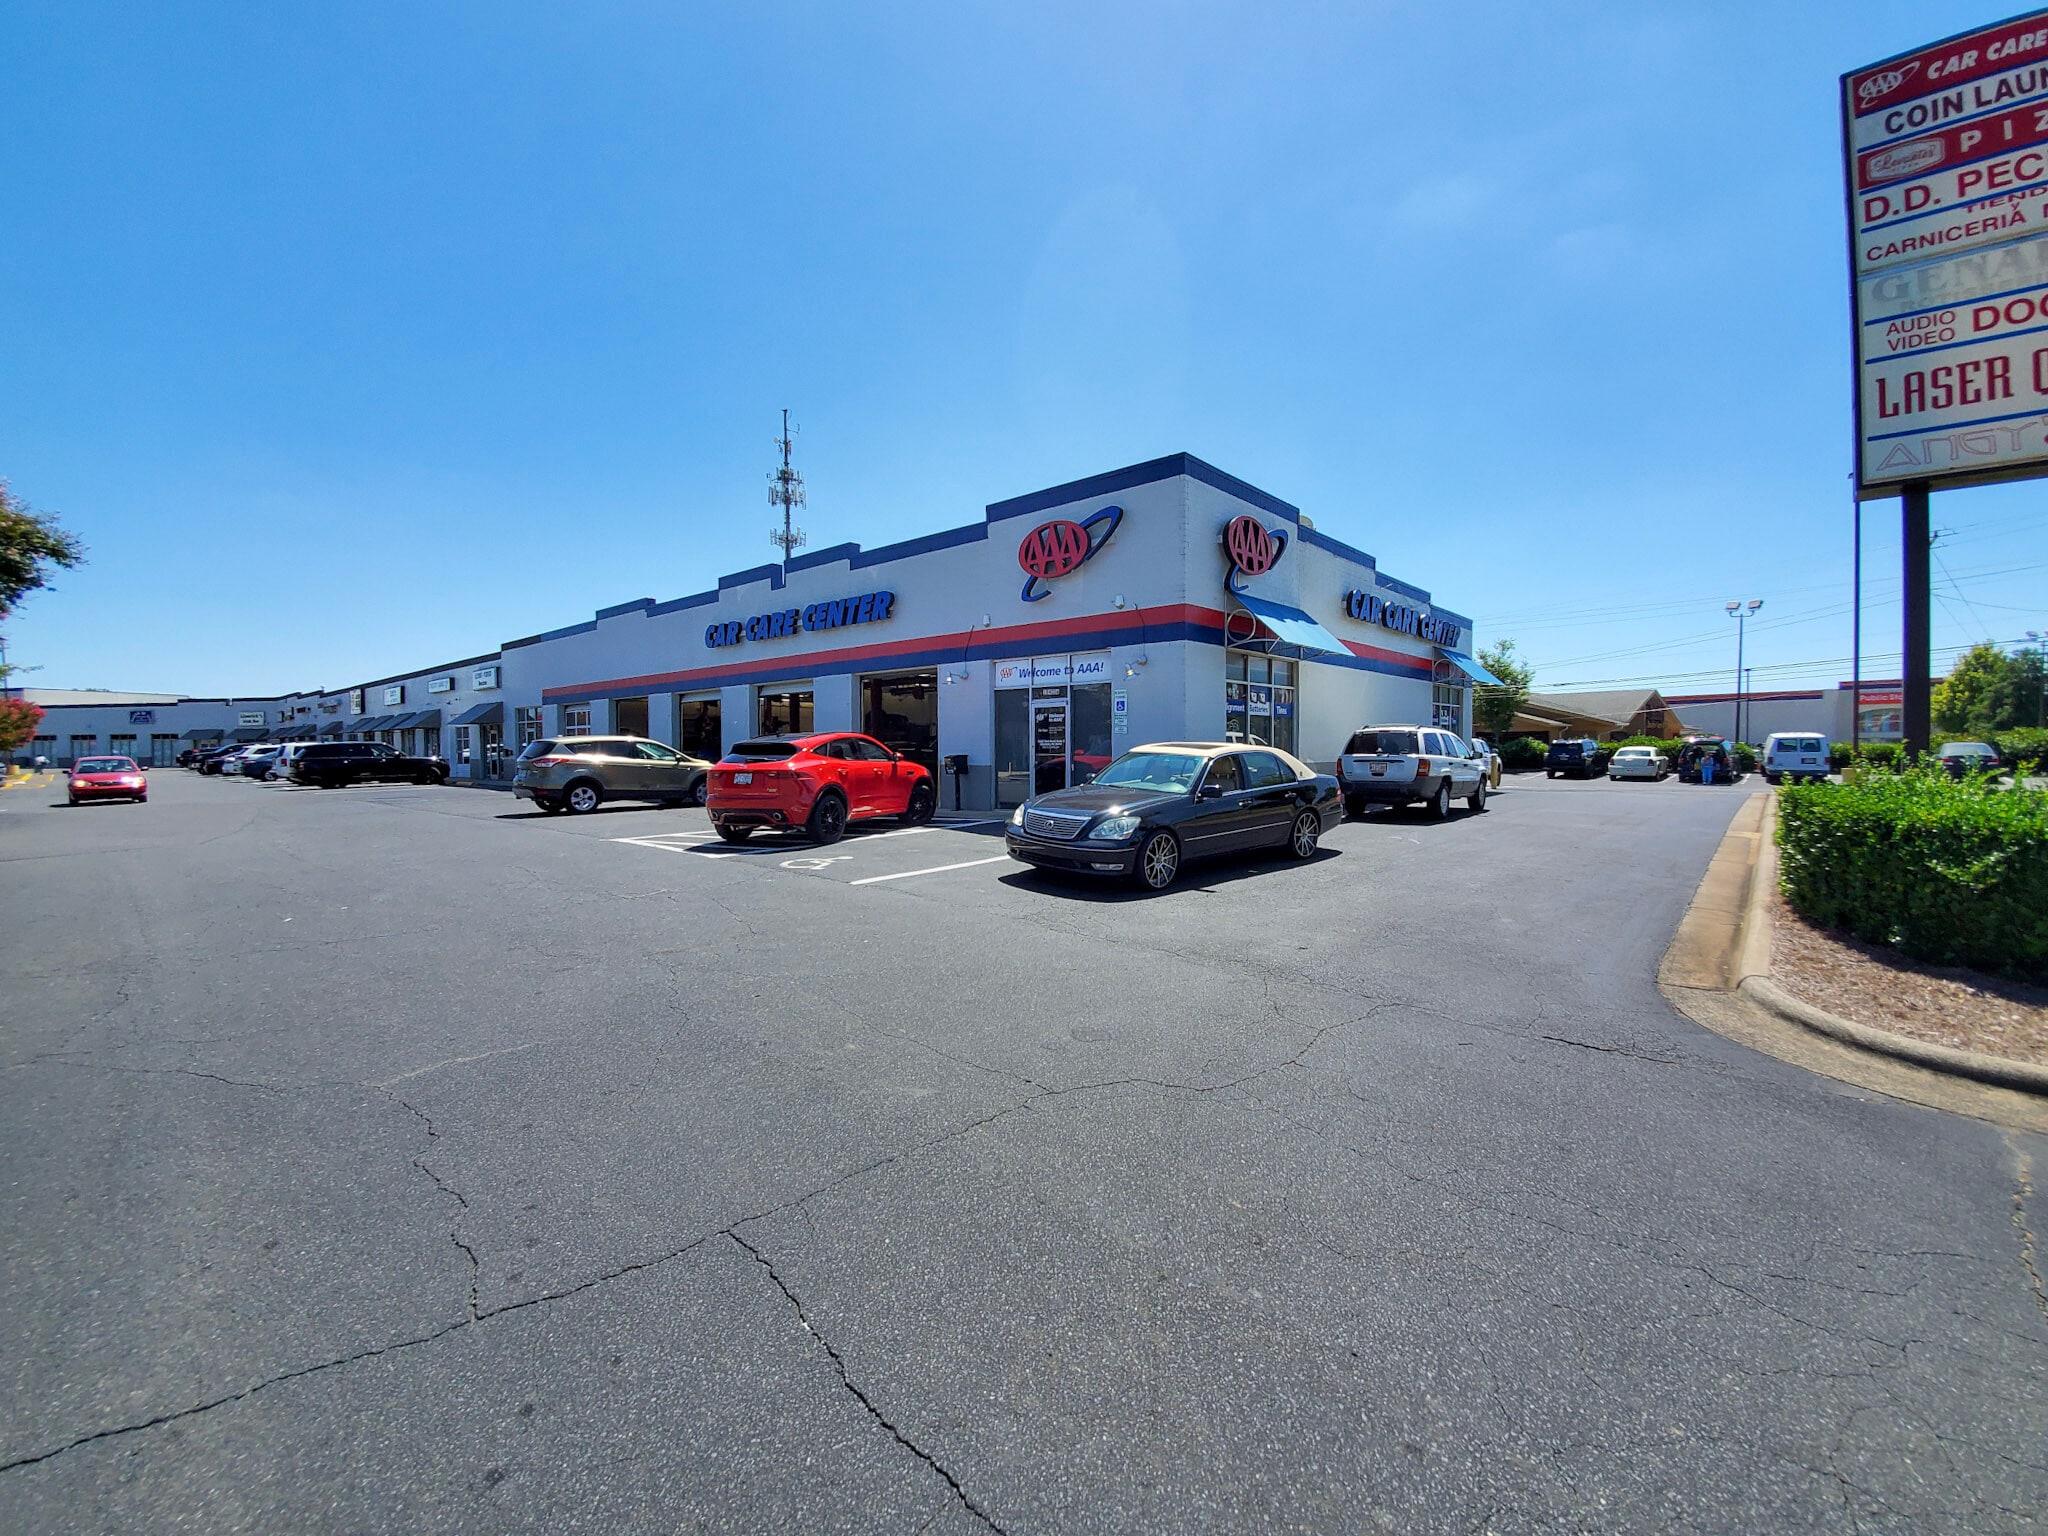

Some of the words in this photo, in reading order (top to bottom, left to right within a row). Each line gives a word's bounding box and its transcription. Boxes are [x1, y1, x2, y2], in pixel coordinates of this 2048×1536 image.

[1859, 72, 1903, 96] AAA
[1927, 50, 1979, 80] CAR
[1986, 28, 2048, 61] CARE
[1884, 91, 1964, 135] COIN
[1863, 184, 1942, 223] D.D.
[1886, 311, 1956, 336] AUDIO
[1887, 327, 1956, 351] VIDEO
[1875, 355, 2014, 419] LASER
[1023, 523, 1087, 577] AAA
[1229, 517, 1271, 573] AAA
[705, 621, 743, 649] CAR
[745, 609, 800, 642] CARE
[802, 590, 896, 632] CENTER
[1347, 588, 1382, 625] CAR
[1381, 600, 1420, 636] CARE
[1418, 613, 1461, 648] CENTER
[1019, 667, 1061, 678] Welcome
[1064, 665, 1074, 675] to
[1077, 661, 1104, 674] AAA!
